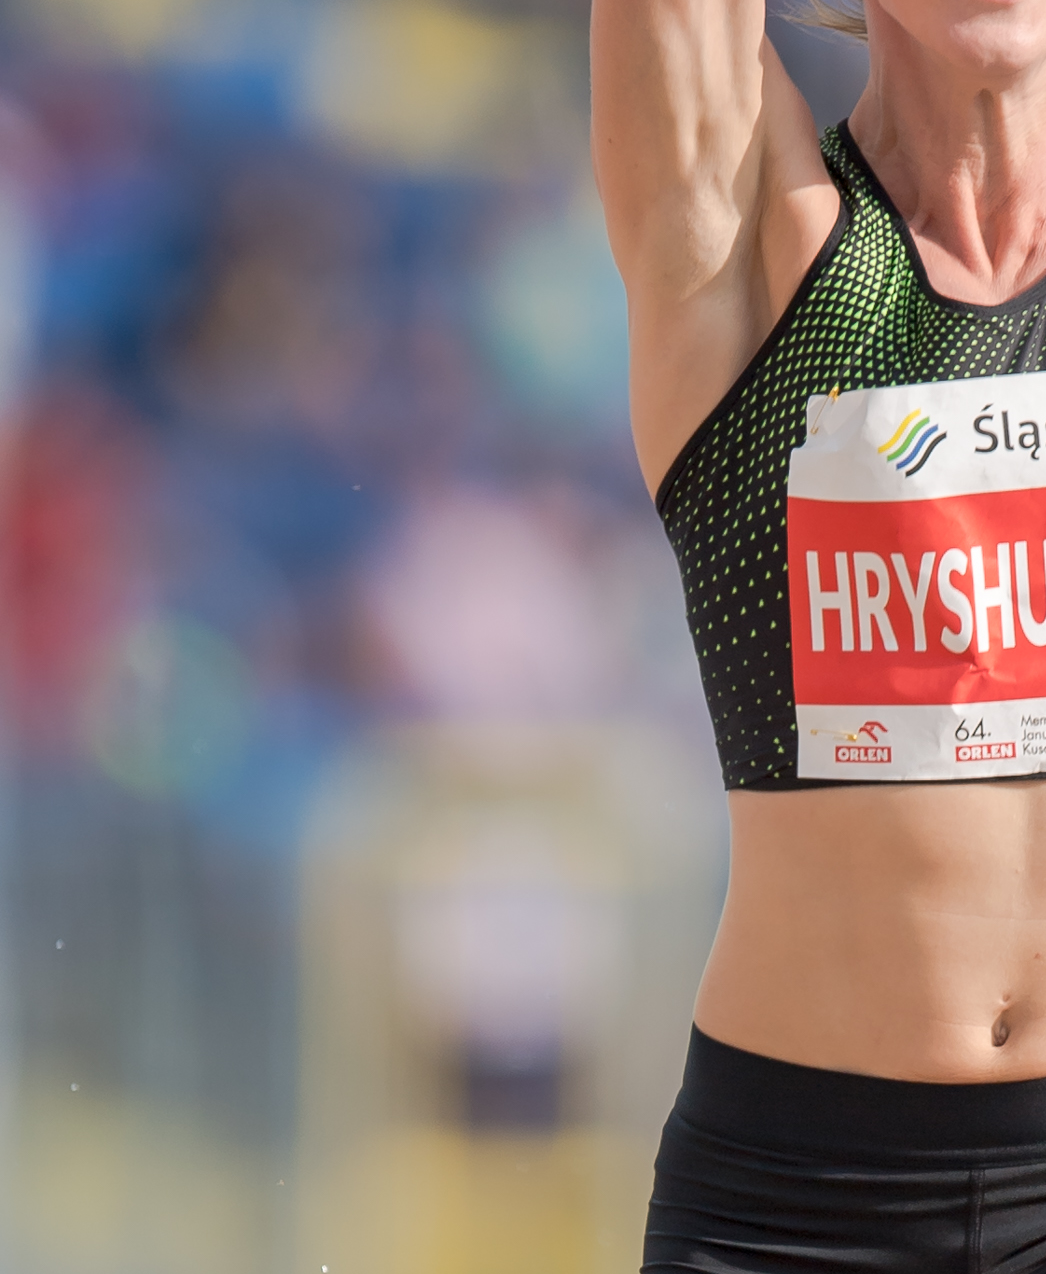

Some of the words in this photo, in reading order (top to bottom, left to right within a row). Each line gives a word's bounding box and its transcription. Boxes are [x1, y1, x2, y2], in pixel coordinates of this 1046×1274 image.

[954, 718, 992, 742] 64.
[837, 747, 890, 762] ORLEN
[957, 744, 1014, 761] ORLEN
